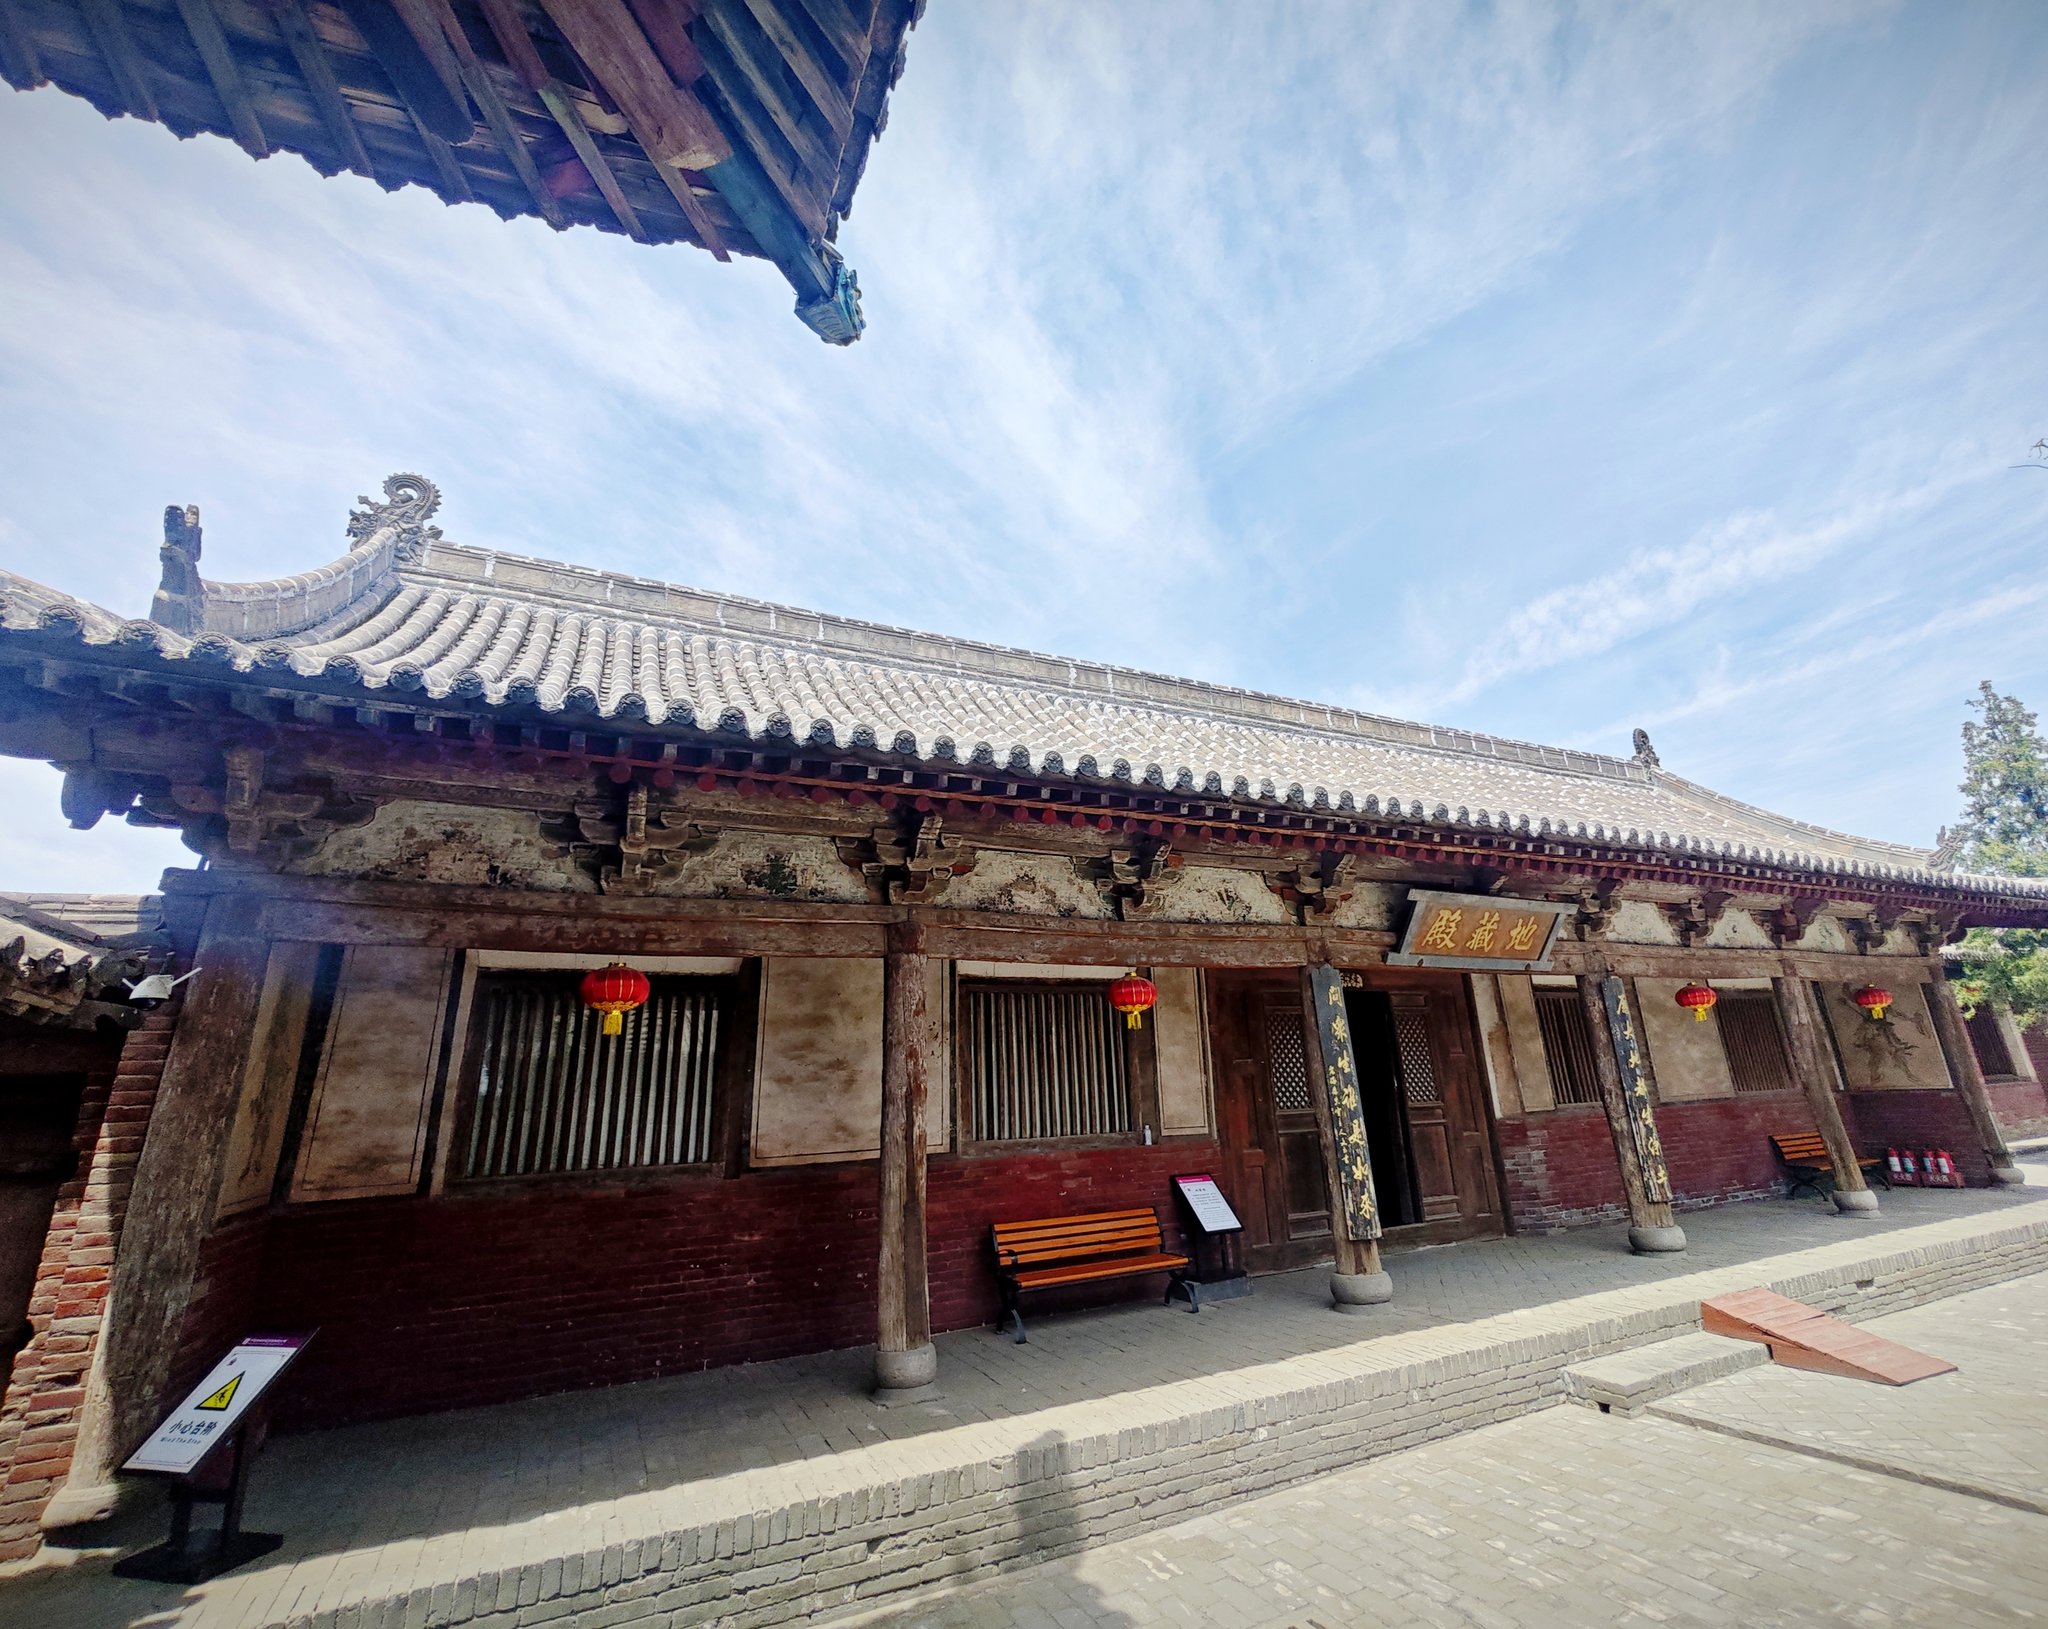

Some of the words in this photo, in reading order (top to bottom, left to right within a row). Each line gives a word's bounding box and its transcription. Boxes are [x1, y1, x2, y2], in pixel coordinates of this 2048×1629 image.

[1421, 908, 1538, 953] 地藏殿
[168, 1419, 218, 1436] 小心台阶
